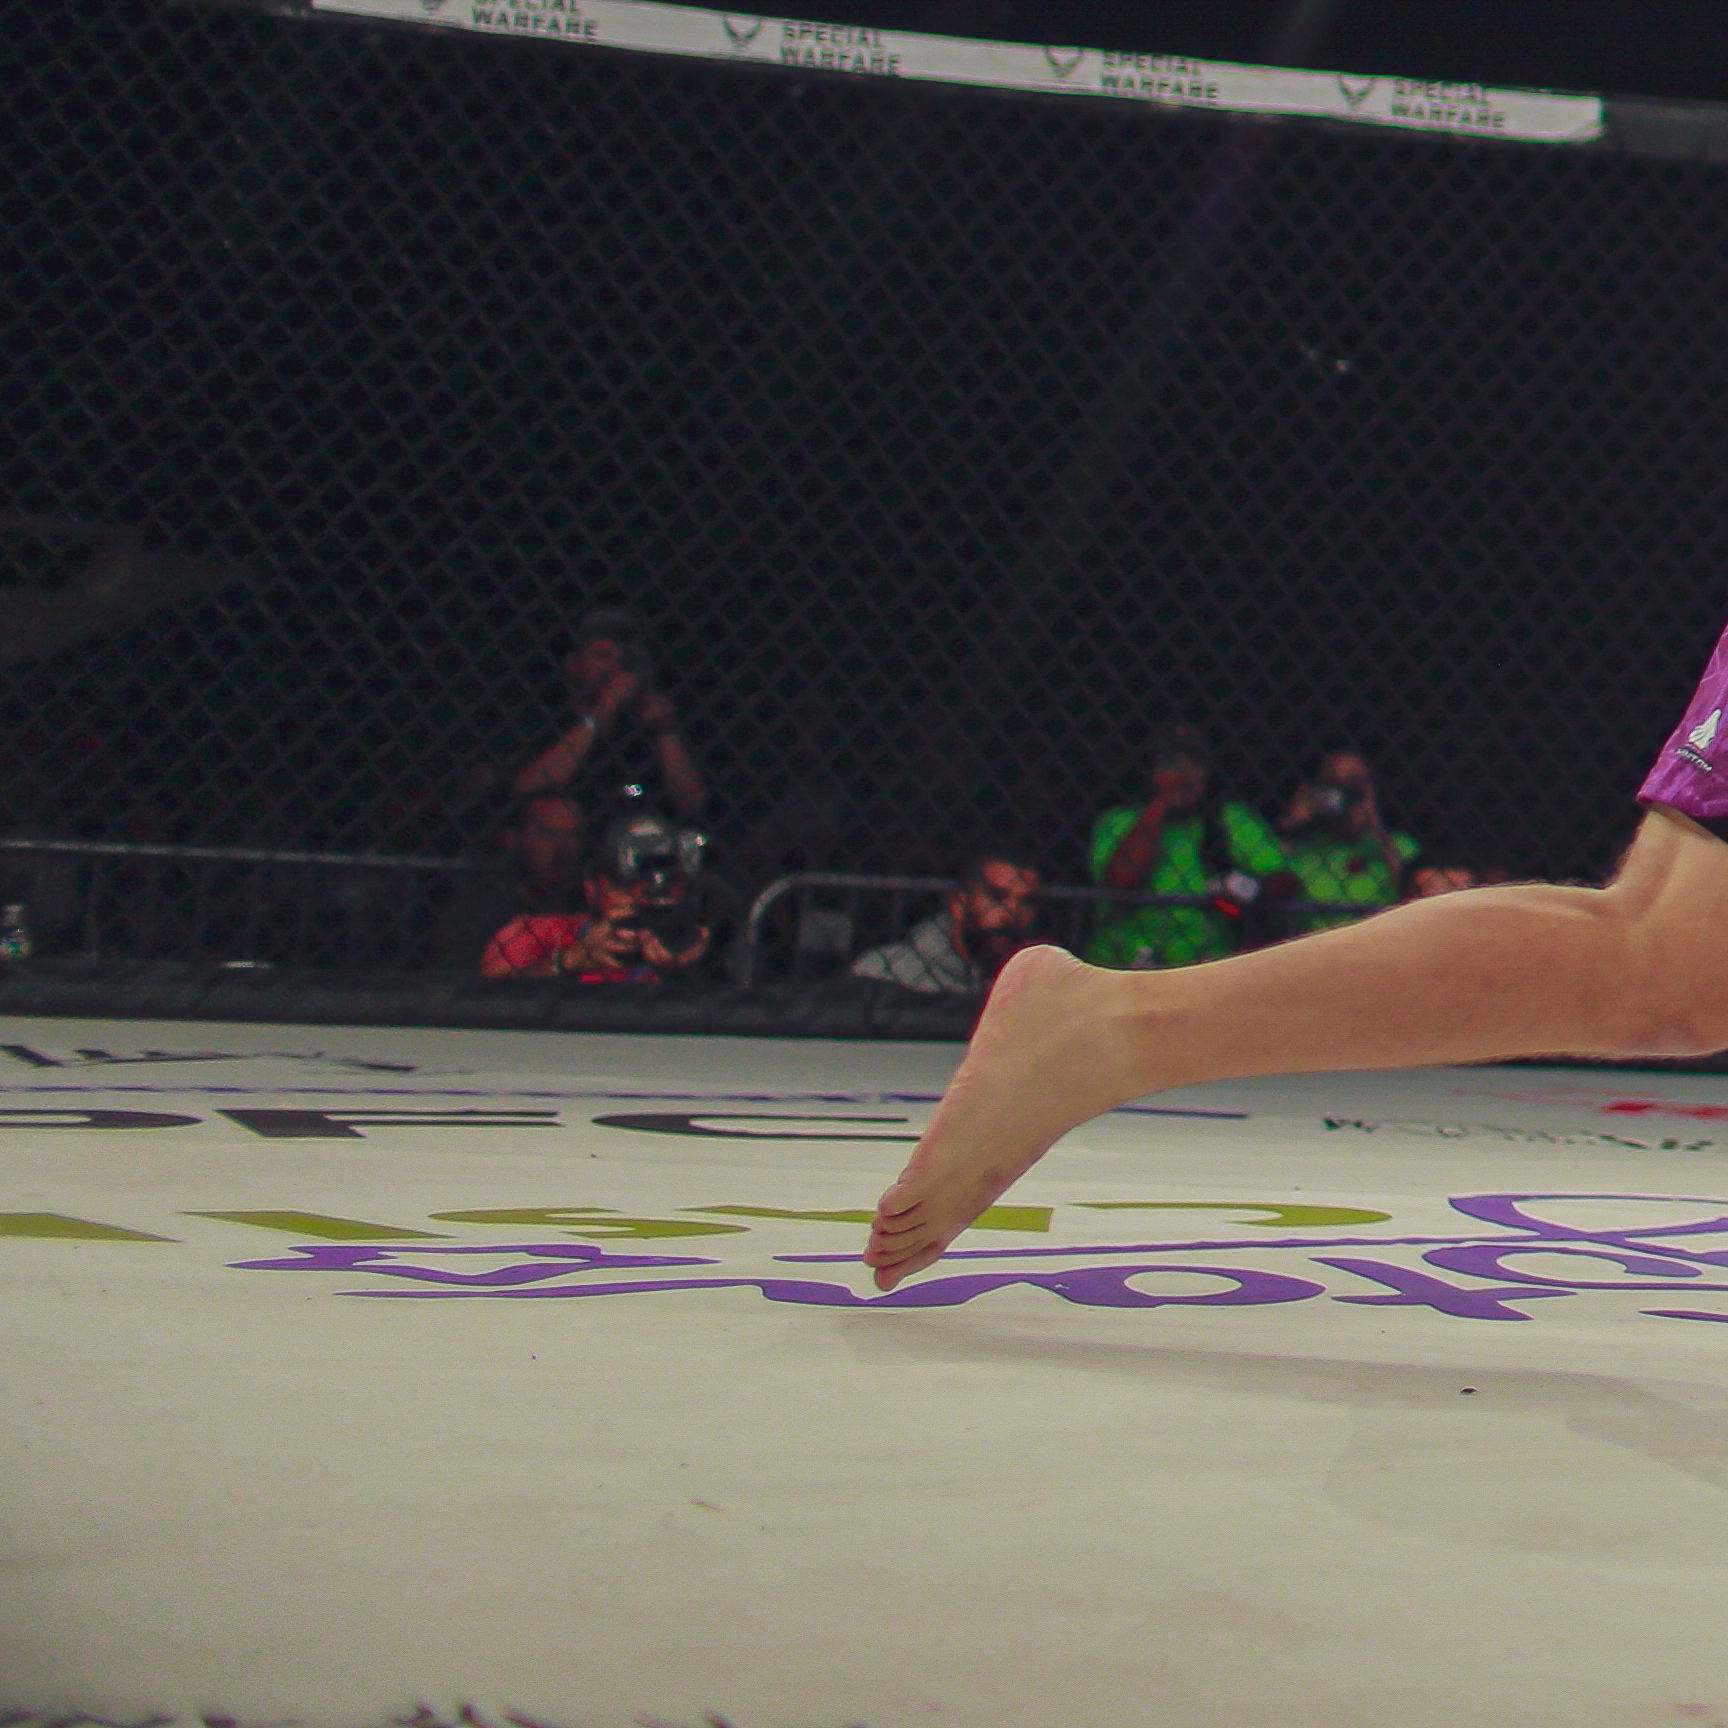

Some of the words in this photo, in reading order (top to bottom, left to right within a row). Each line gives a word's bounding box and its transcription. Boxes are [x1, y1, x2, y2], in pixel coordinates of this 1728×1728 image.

[472, 6, 598, 38] WARFARE
[782, 21, 885, 50] SPECIAL
[780, 46, 902, 75] WARFARE
[1100, 75, 1220, 106] WARFARE
